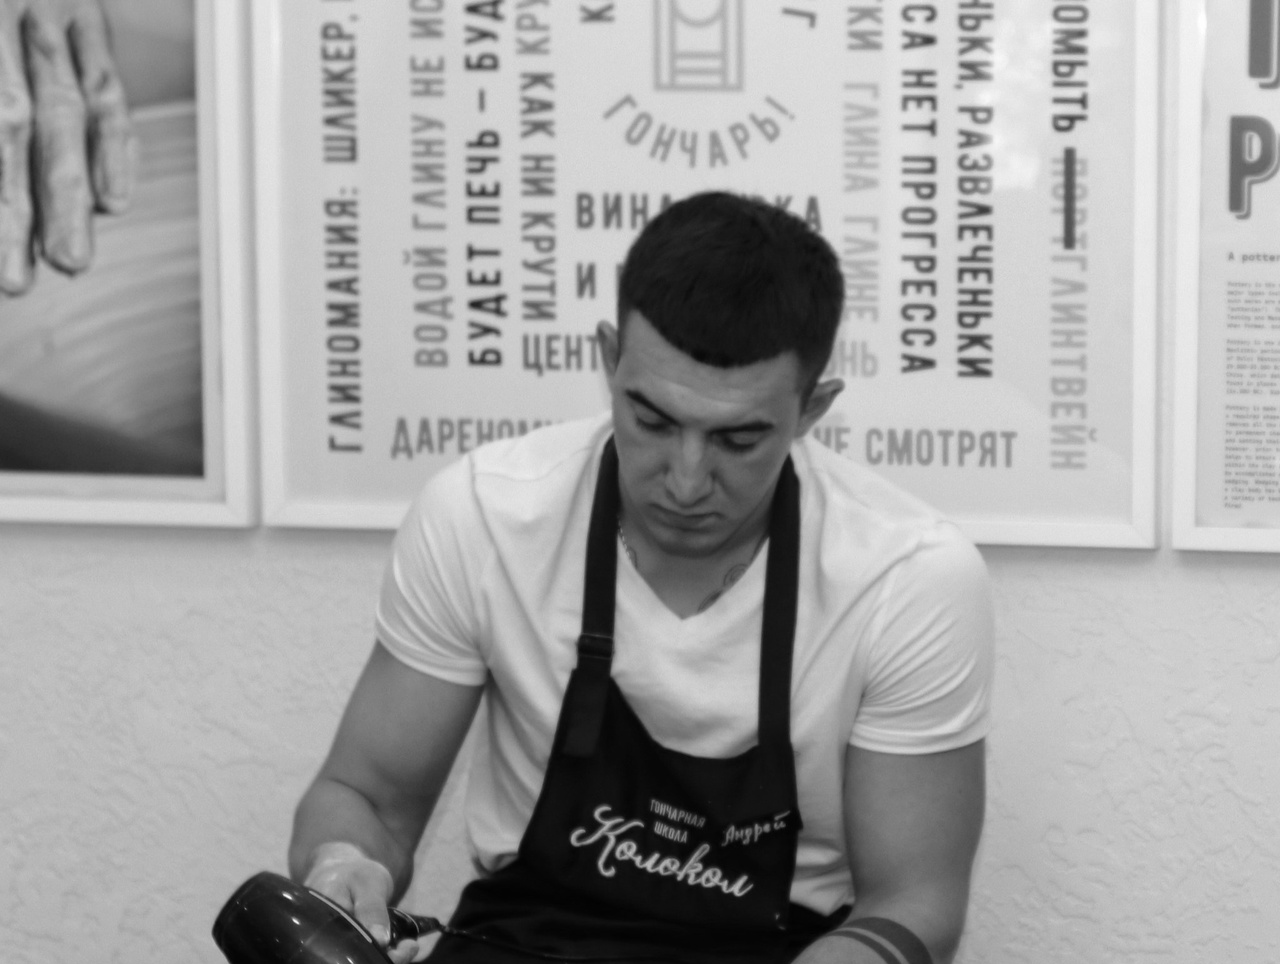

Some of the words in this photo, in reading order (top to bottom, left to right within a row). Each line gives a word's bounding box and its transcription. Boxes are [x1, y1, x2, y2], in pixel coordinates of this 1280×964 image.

[411, 55, 445, 98] НЕ
[520, 72, 555, 138] КАК
[901, 69, 937, 137] НЕТ
[1052, 0, 1089, 133] ОМЫТЬ
[412, 114, 447, 230] ГЛИНУ
[466, 130, 501, 224] ПЕЧЬ
[521, 154, 556, 196] НИ
[843, 82, 879, 194] ГЛИНА
[521, 212, 557, 320] КРУТИ
[843, 216, 879, 322] ГЛИНЕ
[901, 156, 938, 374] ПРОГРЕССА
[957, 105, 994, 378] РАЗВЛЕЧЕНЬКИ
[1228, 252, 1235, 261] A
[324, 187, 362, 453] ГЛИНОМАНИЯ:
[403, 247, 453, 367] ВОДОЙ
[467, 245, 507, 366] БУДЕТ
[865, 427, 1018, 468] СМОТРЯТ
[570, 804, 754, 897] Колокол
[650, 799, 706, 828] ГОНЧАРНАЯ
[654, 821, 688, 844] ШКОЛА
